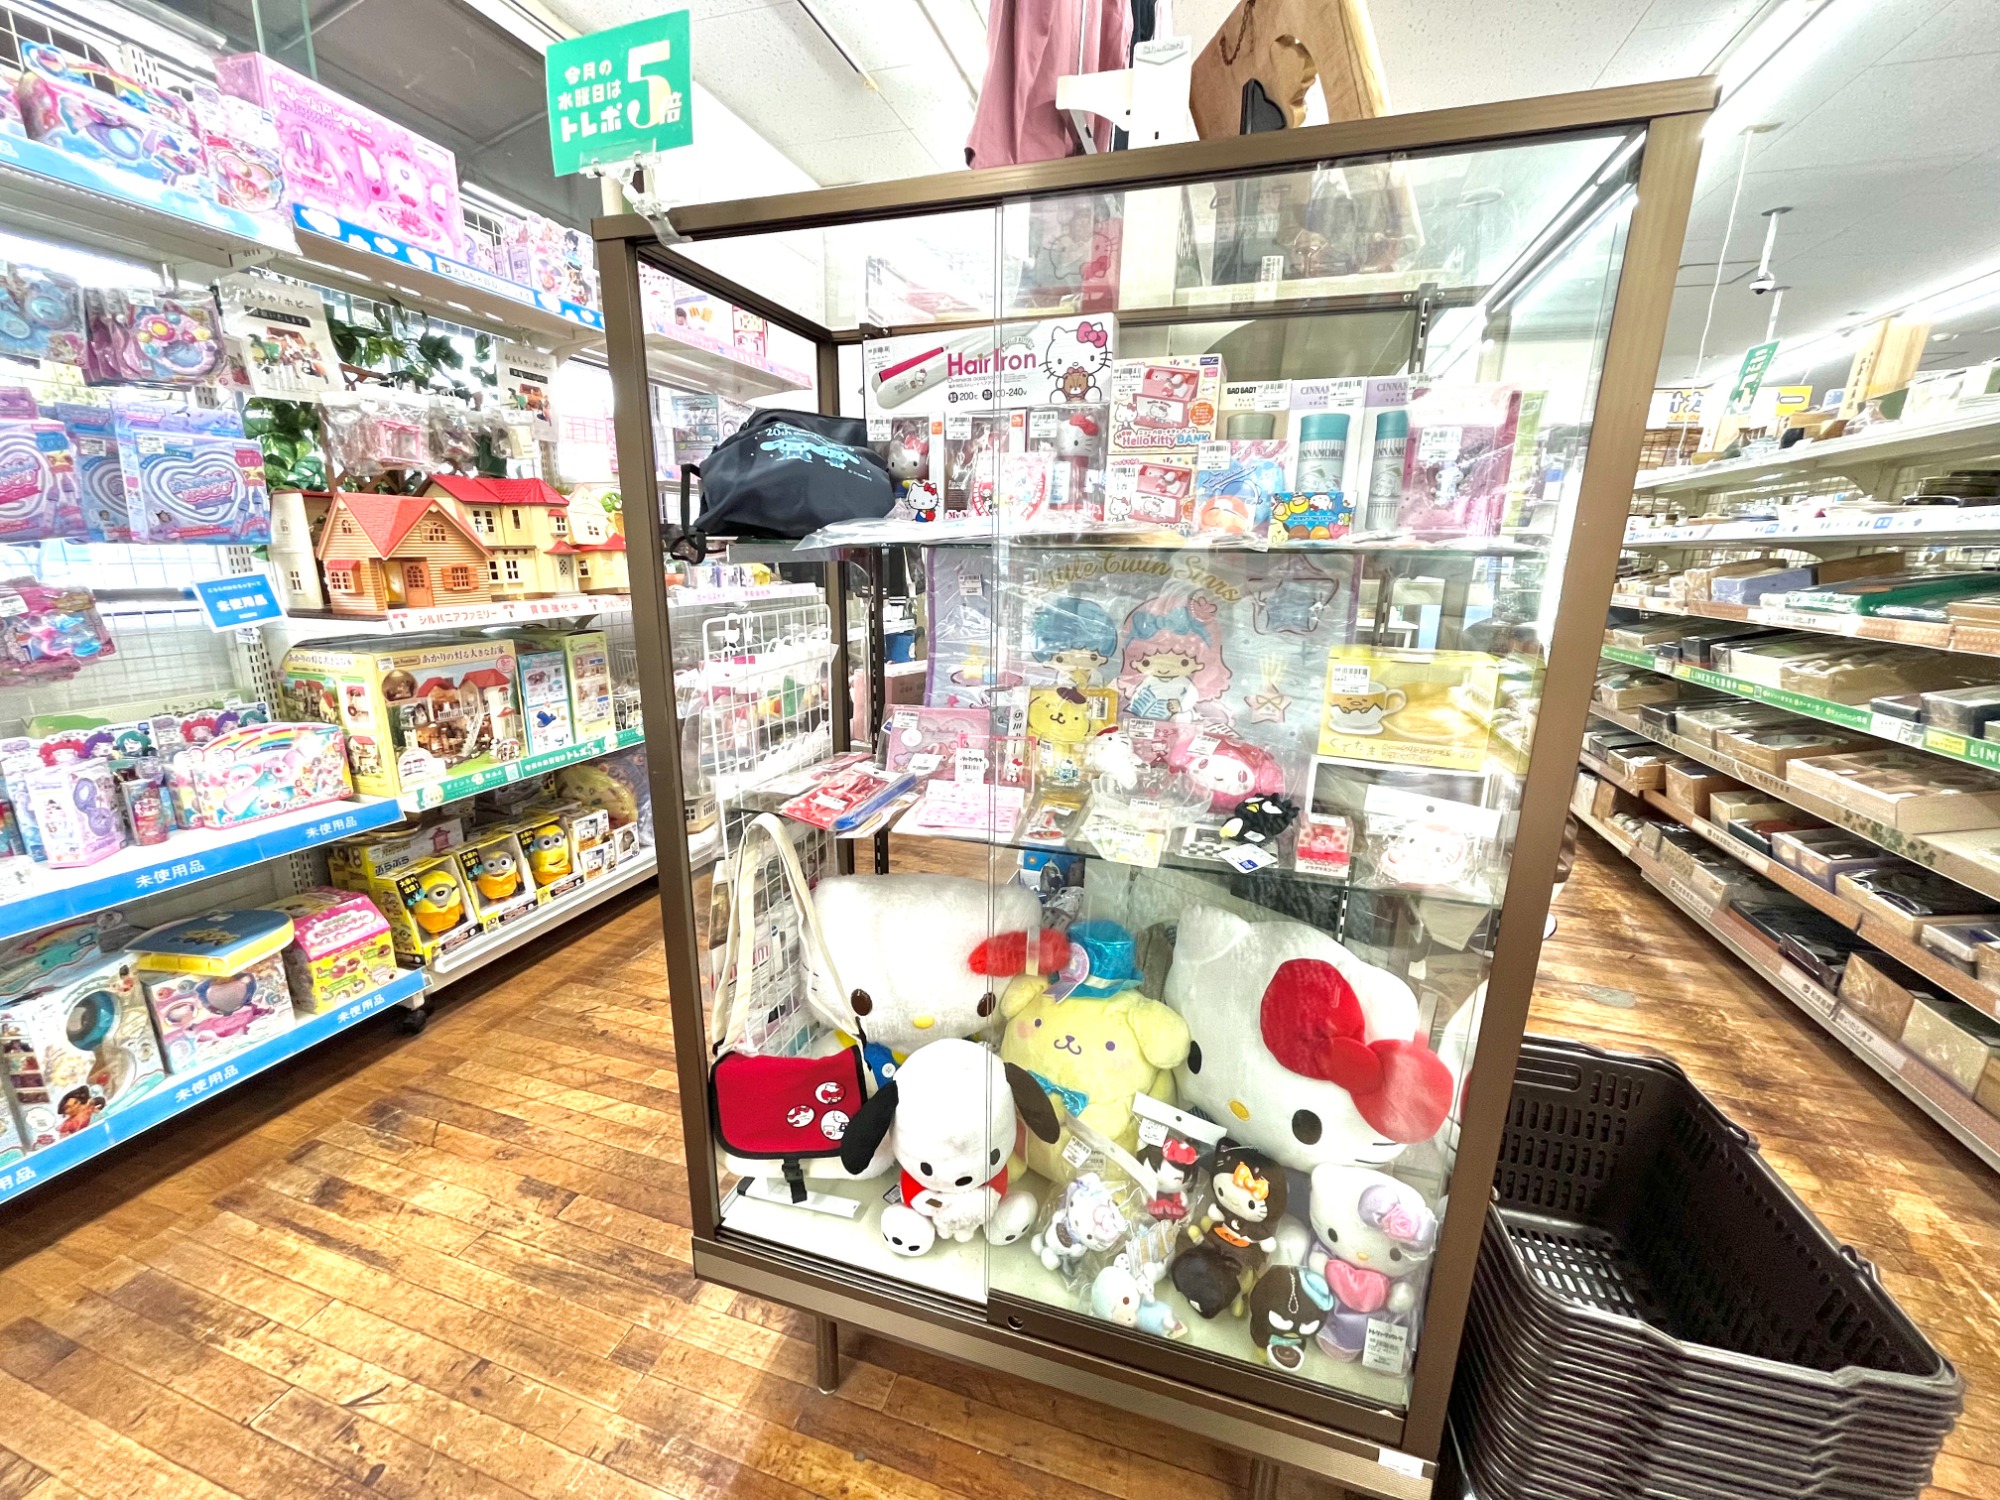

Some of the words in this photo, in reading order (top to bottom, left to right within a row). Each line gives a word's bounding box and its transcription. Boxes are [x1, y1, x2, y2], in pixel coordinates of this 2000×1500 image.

[564, 59, 612, 85] 今月の
[558, 79, 621, 110] 水曜日は
[560, 102, 622, 143] トレポ
[947, 352, 991, 377] Hair
[994, 348, 1037, 372] Iron
[1098, 551, 1172, 576] Twin
[1174, 554, 1243, 604] Stars
[216, 594, 268, 612] 未使用品
[418, 610, 498, 625] シルバニアファミリー
[422, 645, 505, 664] あかりの灯る大きなお家
[305, 816, 357, 839] 未使用品
[135, 860, 205, 889] 未使用品
[337, 993, 385, 1025] 未使用品
[175, 1065, 238, 1103] 未使用品
